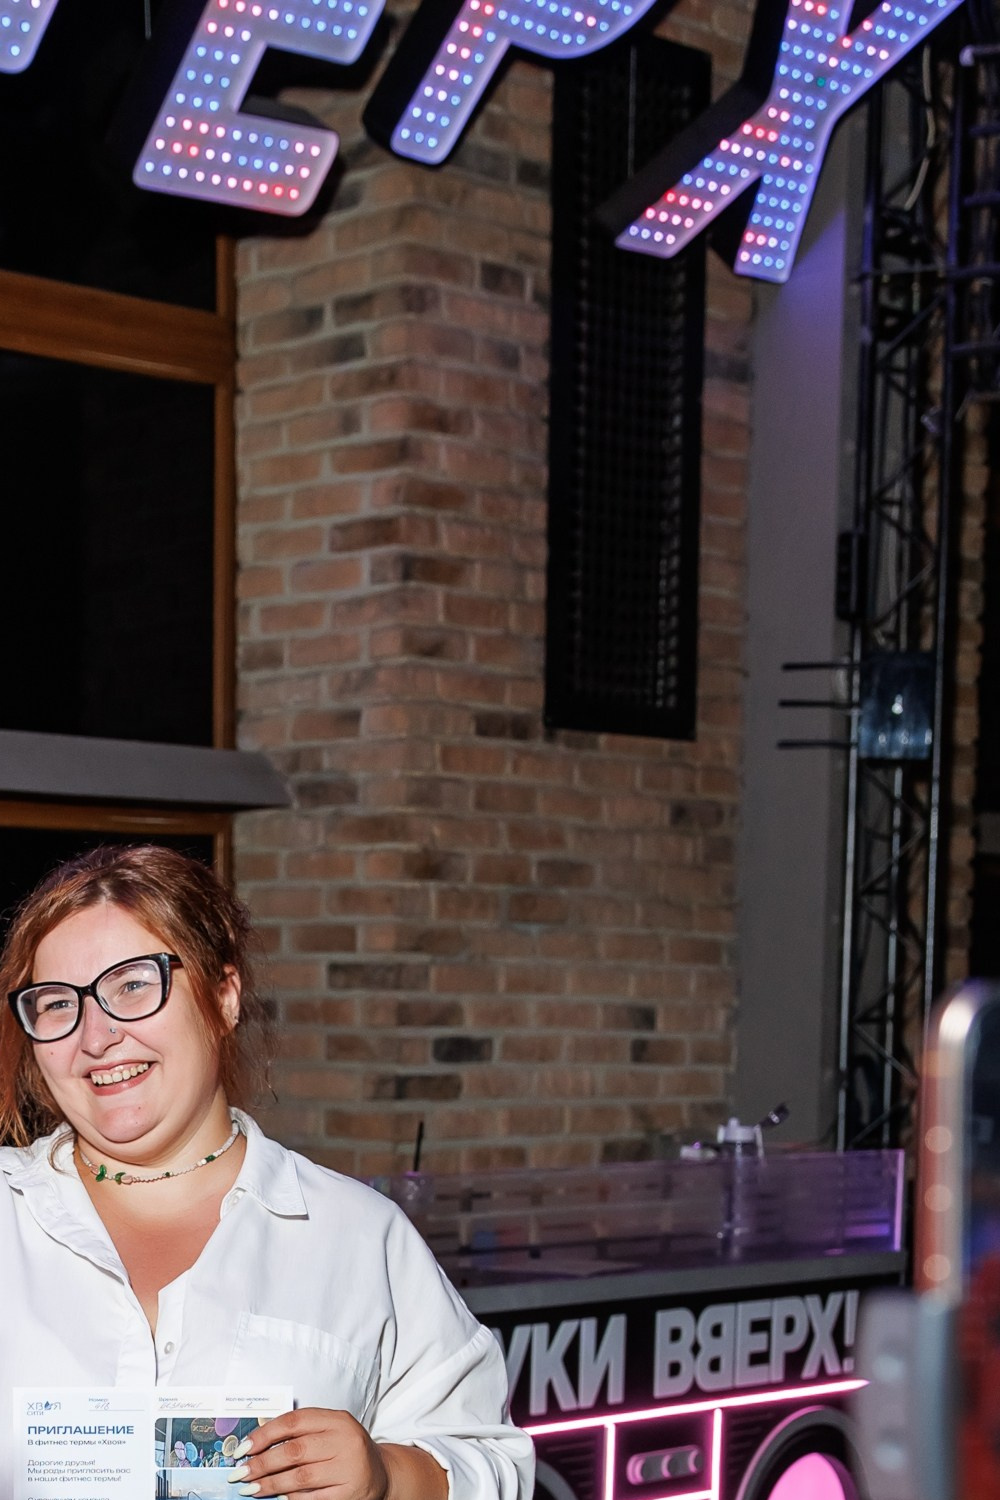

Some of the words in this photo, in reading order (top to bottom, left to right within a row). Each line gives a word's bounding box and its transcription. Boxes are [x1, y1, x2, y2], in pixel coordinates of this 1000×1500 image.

[27, 1425, 135, 1435] ПРИГЛАШЕНИЕ
[27, 1459, 64, 1467] Дорогие
[59, 1475, 92, 1483] фитнес
